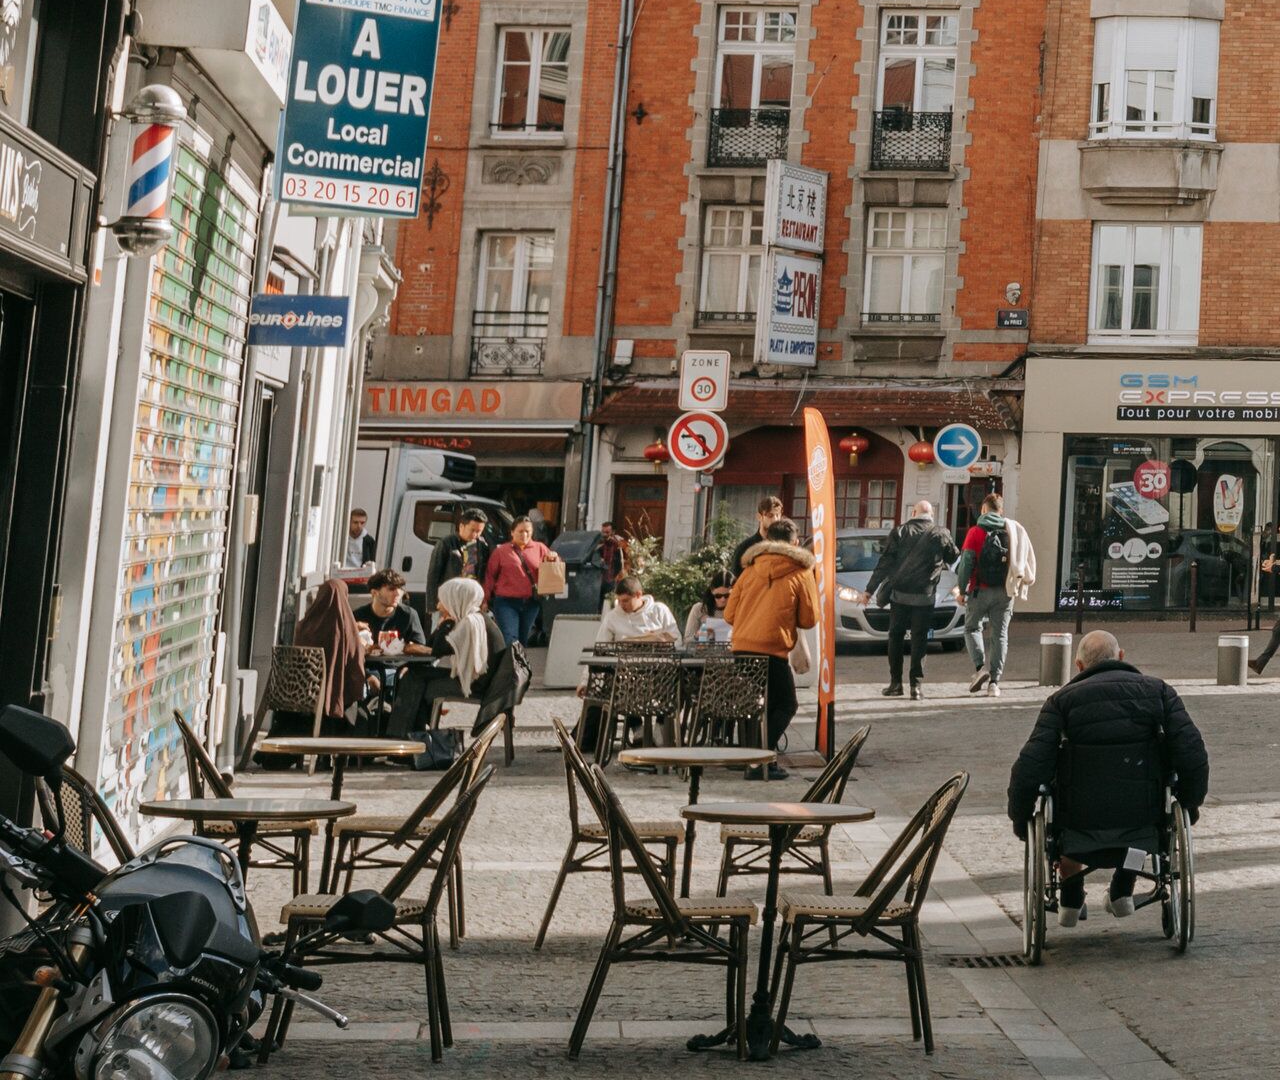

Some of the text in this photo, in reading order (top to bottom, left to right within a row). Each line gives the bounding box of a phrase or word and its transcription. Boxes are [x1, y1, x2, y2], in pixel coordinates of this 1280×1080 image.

[374, 2, 393, 12] TMC
[393, 6, 431, 17] FINANCE
[352, 18, 381, 60] A
[294, 60, 427, 116] LOUER
[327, 117, 388, 146] Local
[287, 142, 421, 179] Commercial
[285, 177, 415, 209] 03 20 15 20 61
[781, 219, 818, 243] RESTAURANT
[792, 270, 818, 319] PEKIN
[691, 358, 720, 367] ZONE
[697, 384, 712, 394] 30
[1120, 374, 1199, 388] GSM
[367, 387, 502, 413] TIMGAD
[1120, 406, 1150, 418] Tout
[1157, 409, 1191, 420] pour
[1197, 408, 1236, 418] votre
[1141, 473, 1167, 492] 30
[191, 975, 219, 994] HONDA
